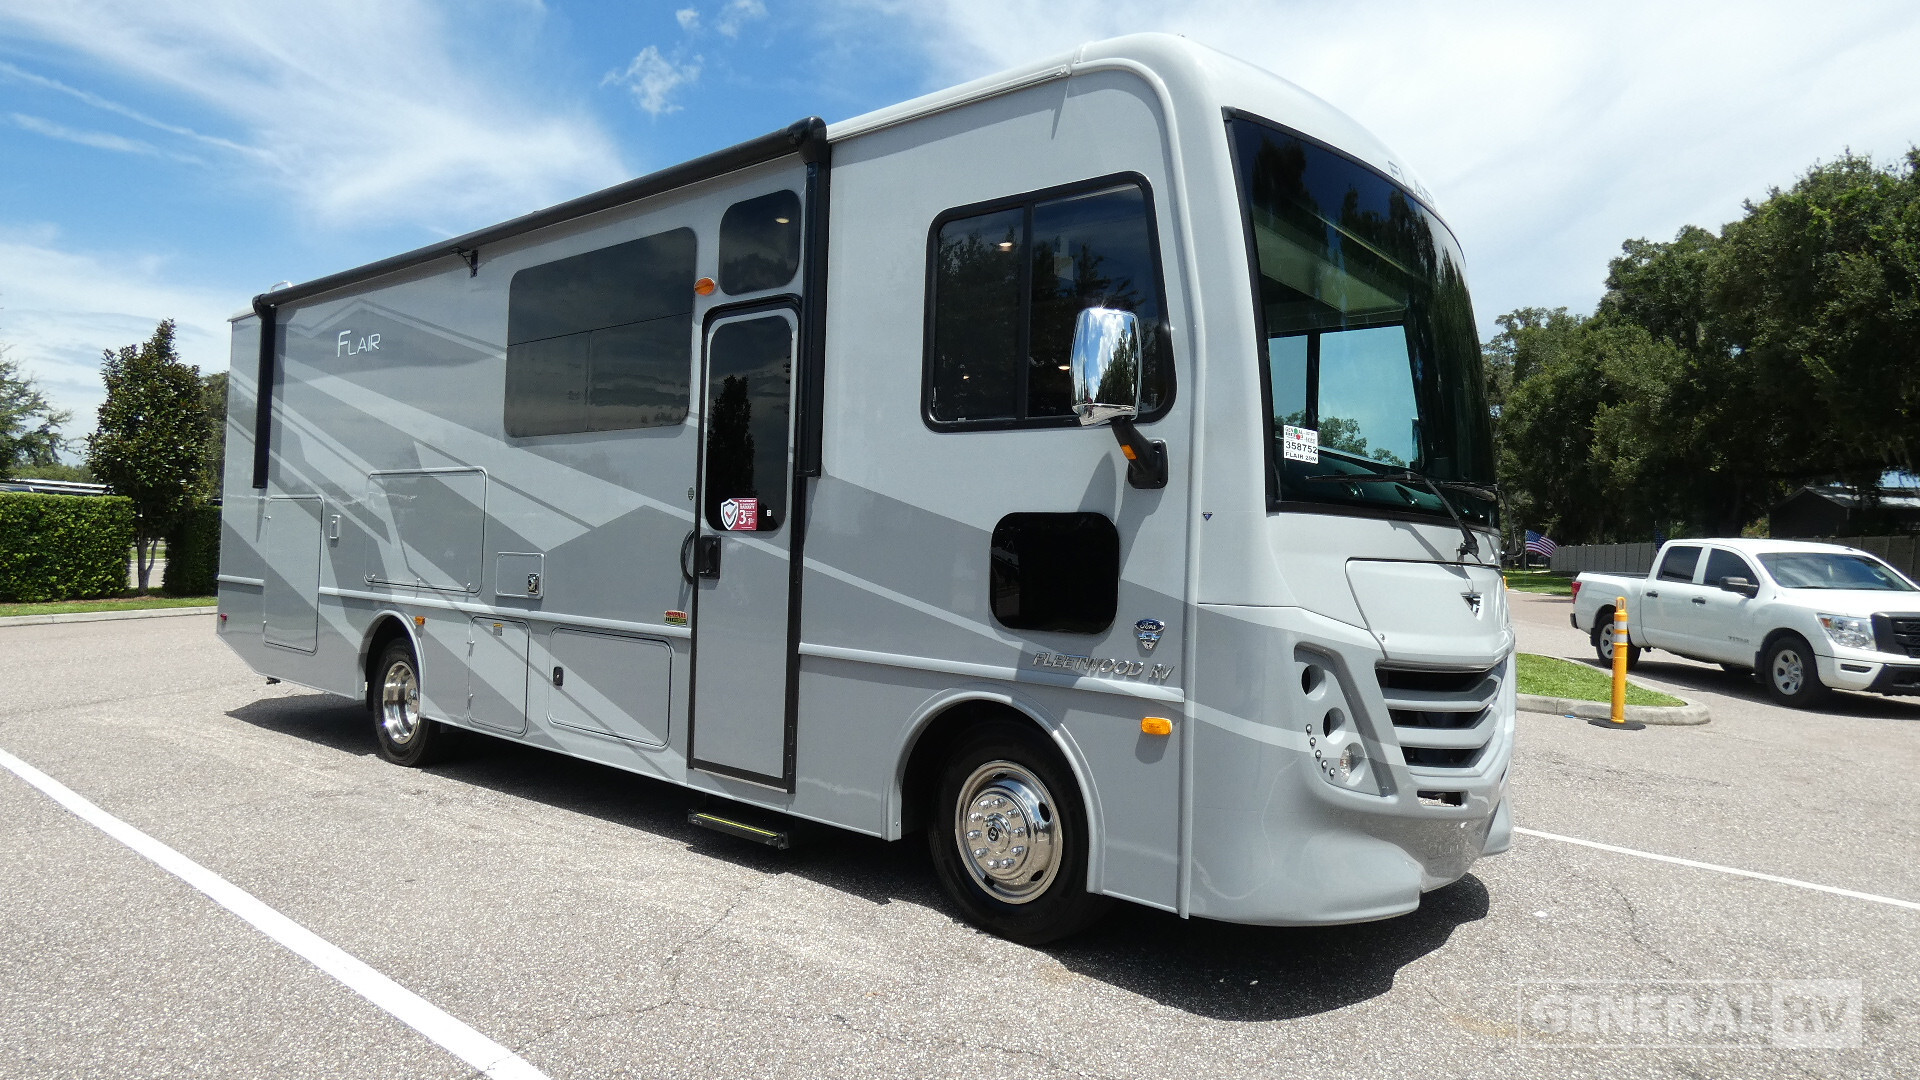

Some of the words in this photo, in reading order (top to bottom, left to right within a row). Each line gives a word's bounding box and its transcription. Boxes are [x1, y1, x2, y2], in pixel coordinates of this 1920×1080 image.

[1285, 440, 1318, 455] 358752
[1032, 651, 1145, 677] FLEETWOOD
[1149, 663, 1176, 680] RV
